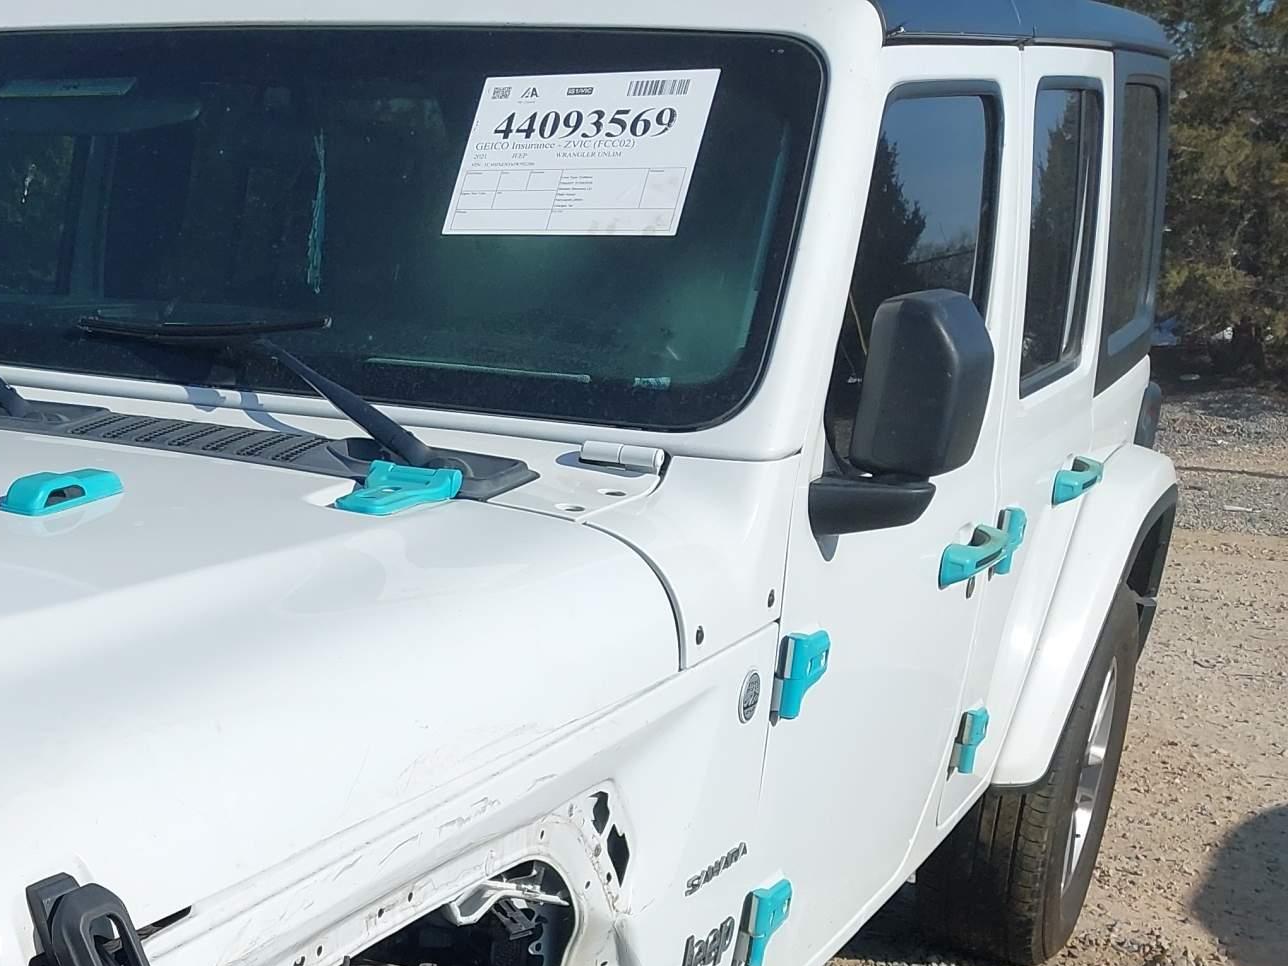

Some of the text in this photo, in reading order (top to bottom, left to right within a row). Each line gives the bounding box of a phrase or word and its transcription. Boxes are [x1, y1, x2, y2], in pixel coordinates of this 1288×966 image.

[494, 107, 678, 140] 44093569
[475, 142, 509, 151] GEICO
[512, 141, 555, 149] Insurance
[565, 140, 591, 149] ZVIC
[593, 139, 636, 149] (FCC02)
[685, 842, 747, 896] SAHARA
